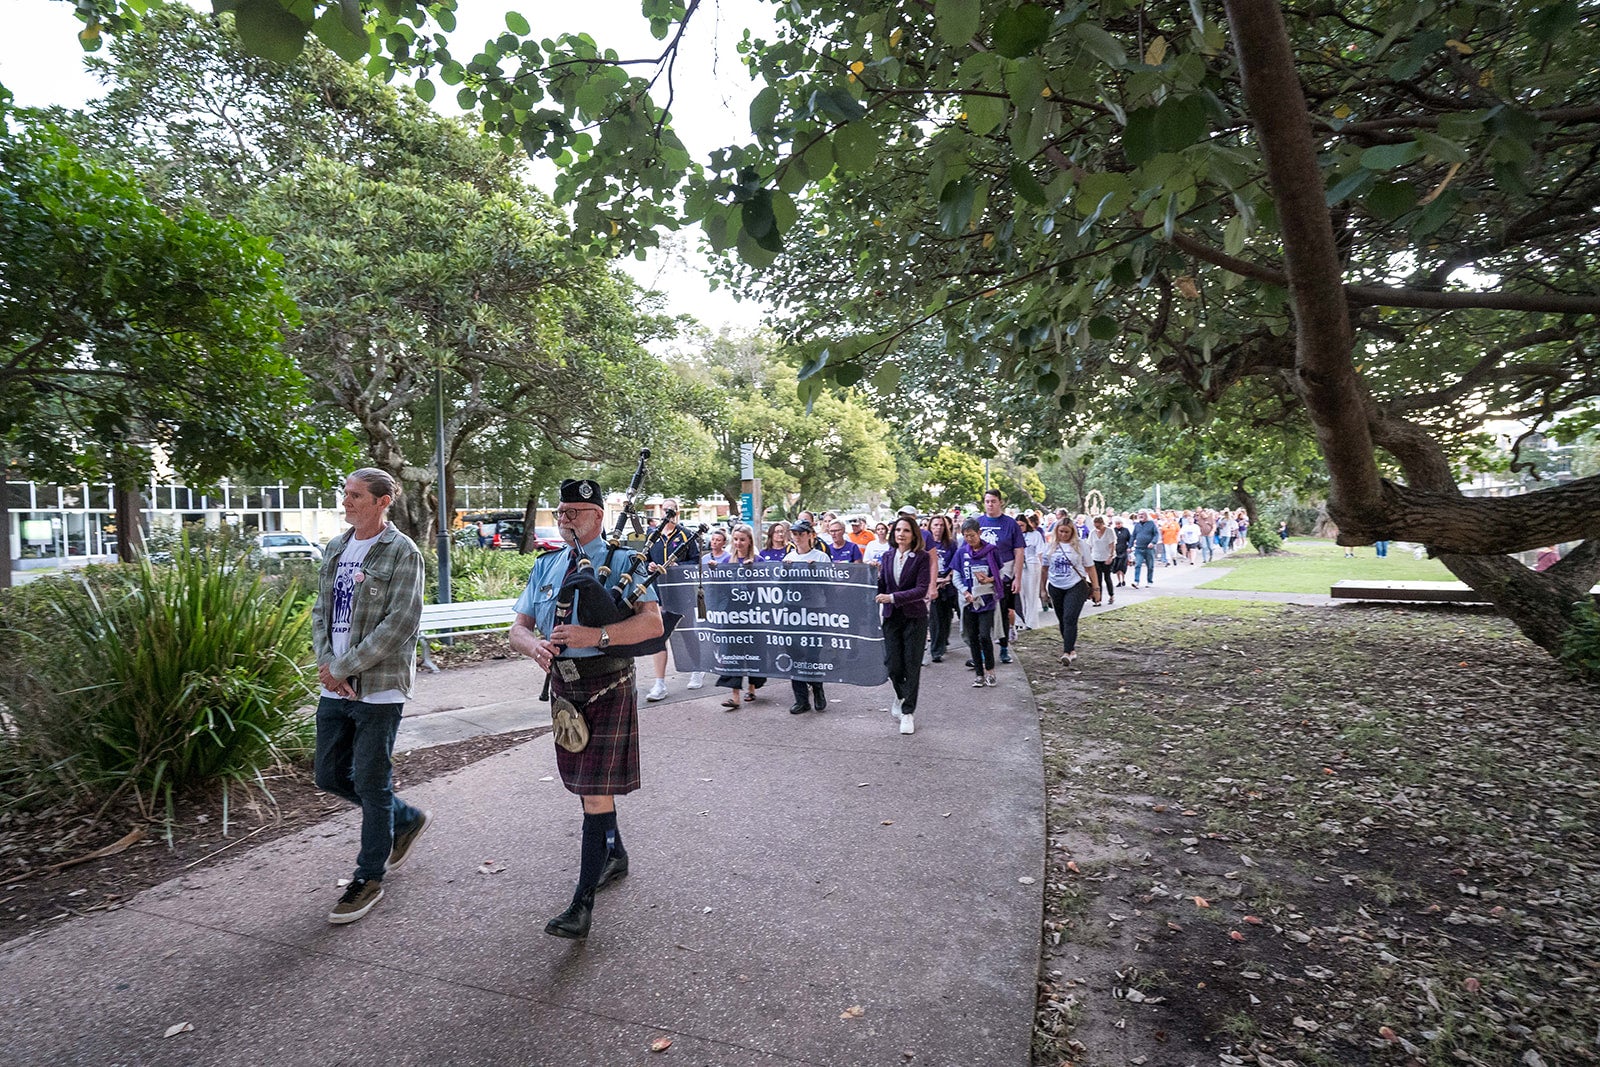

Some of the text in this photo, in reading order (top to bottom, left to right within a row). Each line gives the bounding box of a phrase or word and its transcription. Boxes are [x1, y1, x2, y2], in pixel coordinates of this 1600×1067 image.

[683, 566, 850, 580] Sunshine Coast Communities
[731, 586, 802, 605] Say NO to
[771, 607, 850, 629] Violence
[766, 634, 792, 646] 1800
[800, 636, 823, 648] 811
[831, 637, 851, 650] 811
